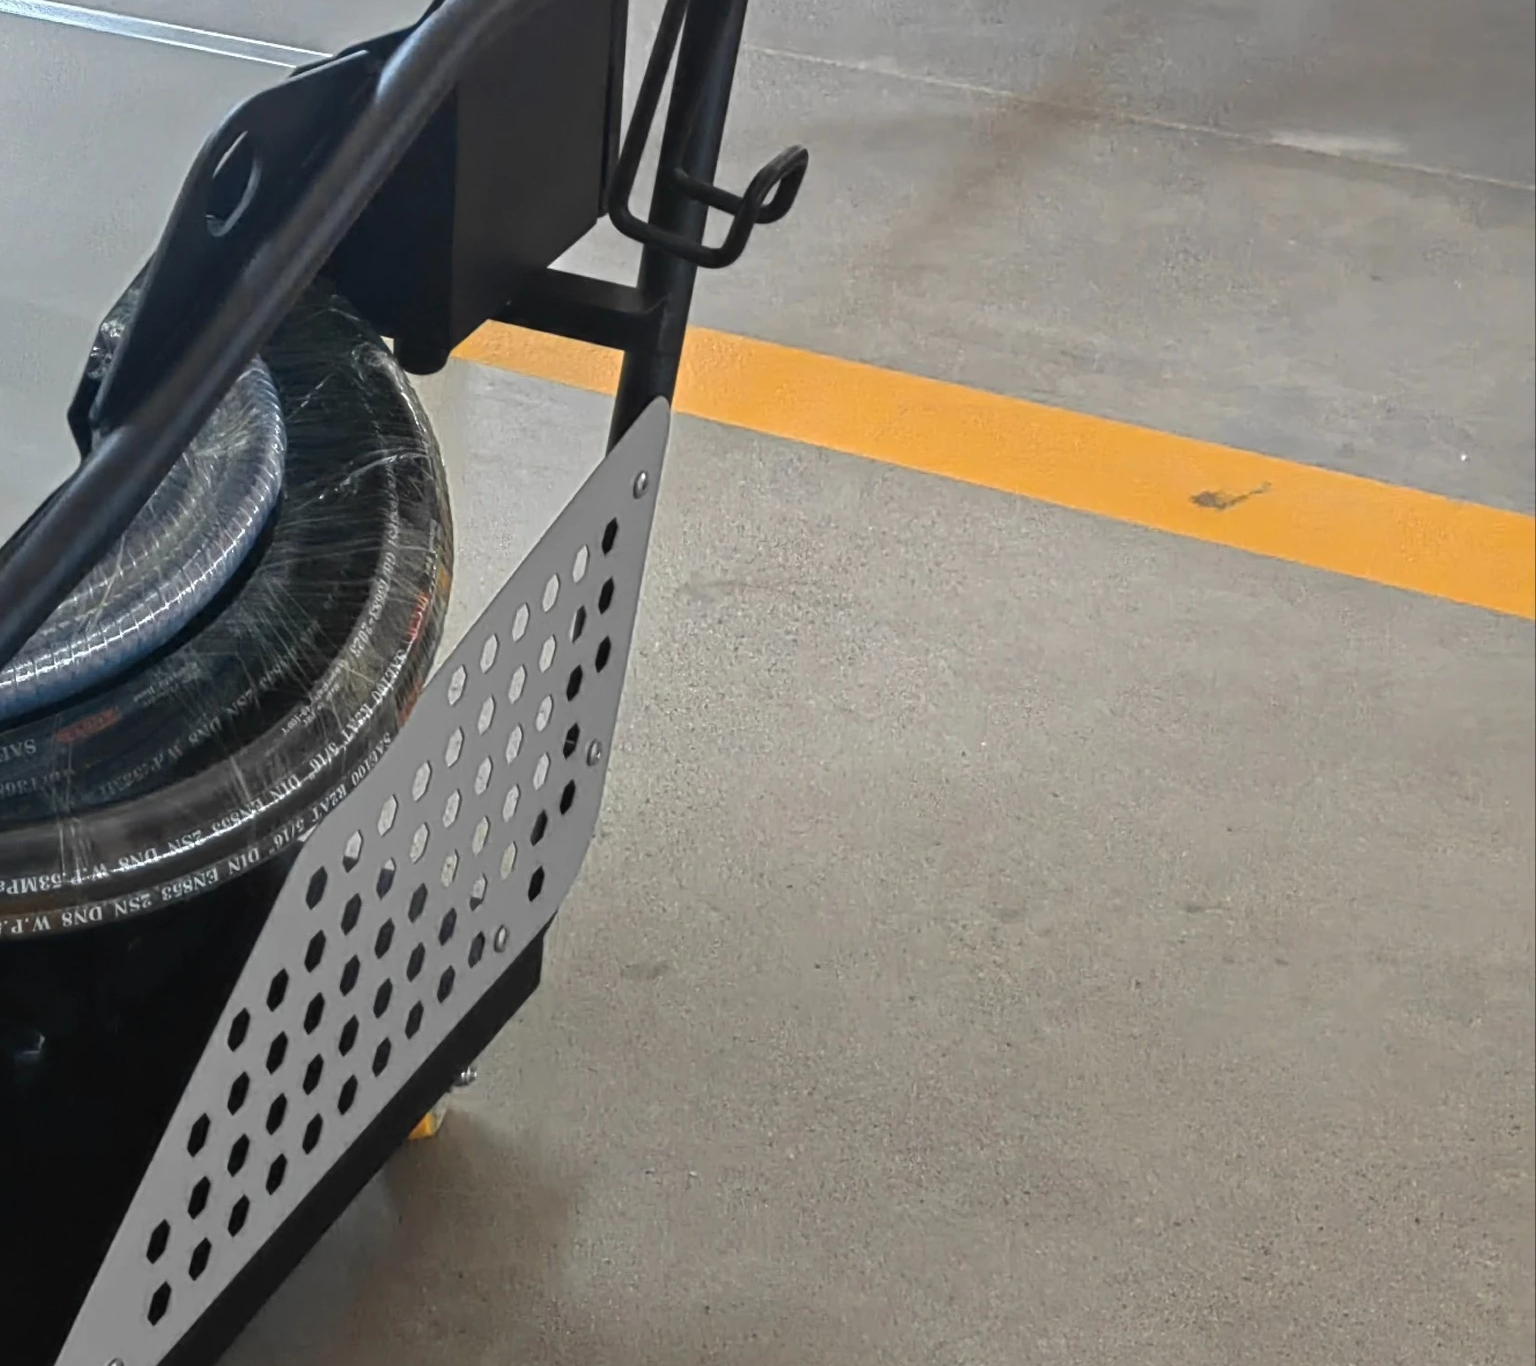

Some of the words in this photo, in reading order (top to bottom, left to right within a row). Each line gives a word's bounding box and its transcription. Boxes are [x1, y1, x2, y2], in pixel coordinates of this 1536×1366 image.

[351, 732, 392, 787] SAE100
[269, 774, 303, 803] DIN
[311, 783, 347, 822] R2AT
[118, 848, 159, 872] DN8
[227, 847, 260, 877] DIN
[161, 867, 219, 902] EN853
[62, 906, 103, 928] DN8
[114, 892, 153, 918] 2SN
